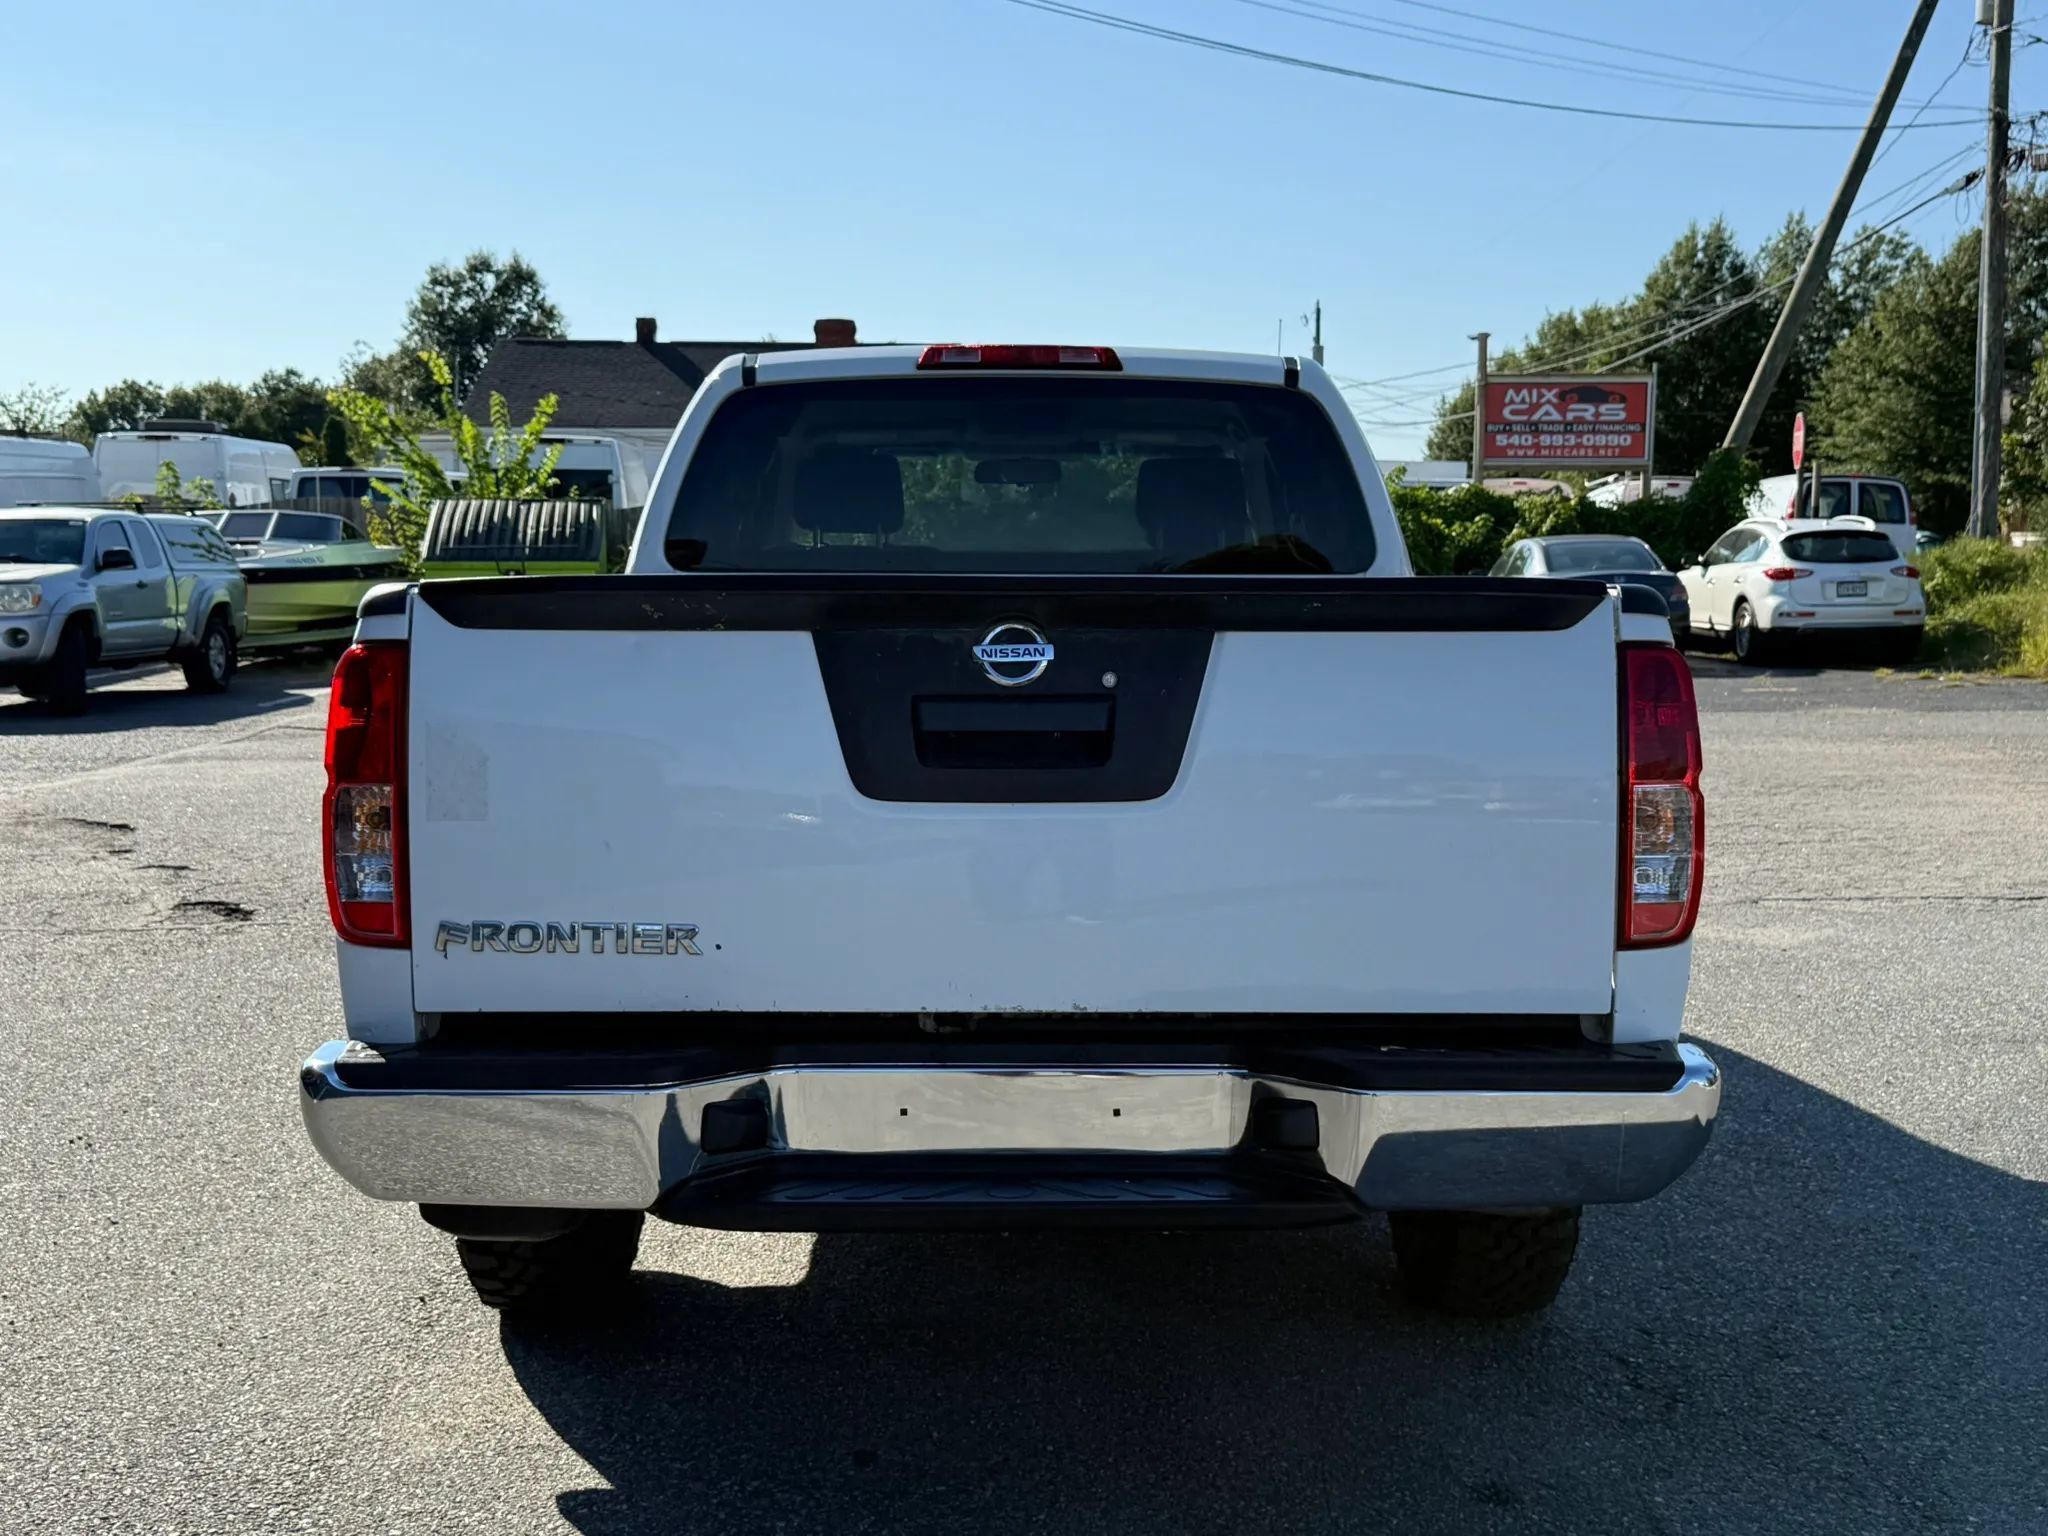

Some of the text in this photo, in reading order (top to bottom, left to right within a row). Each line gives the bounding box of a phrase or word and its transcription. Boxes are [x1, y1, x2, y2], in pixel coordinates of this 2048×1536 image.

[1503, 388, 1560, 404] MIX
[1502, 403, 1627, 421] CARS
[1487, 423, 1641, 432] BUY SELL TRADE EASY FINANCING
[981, 647, 1046, 659] NISSAN
[434, 920, 704, 956] FRONTIER
